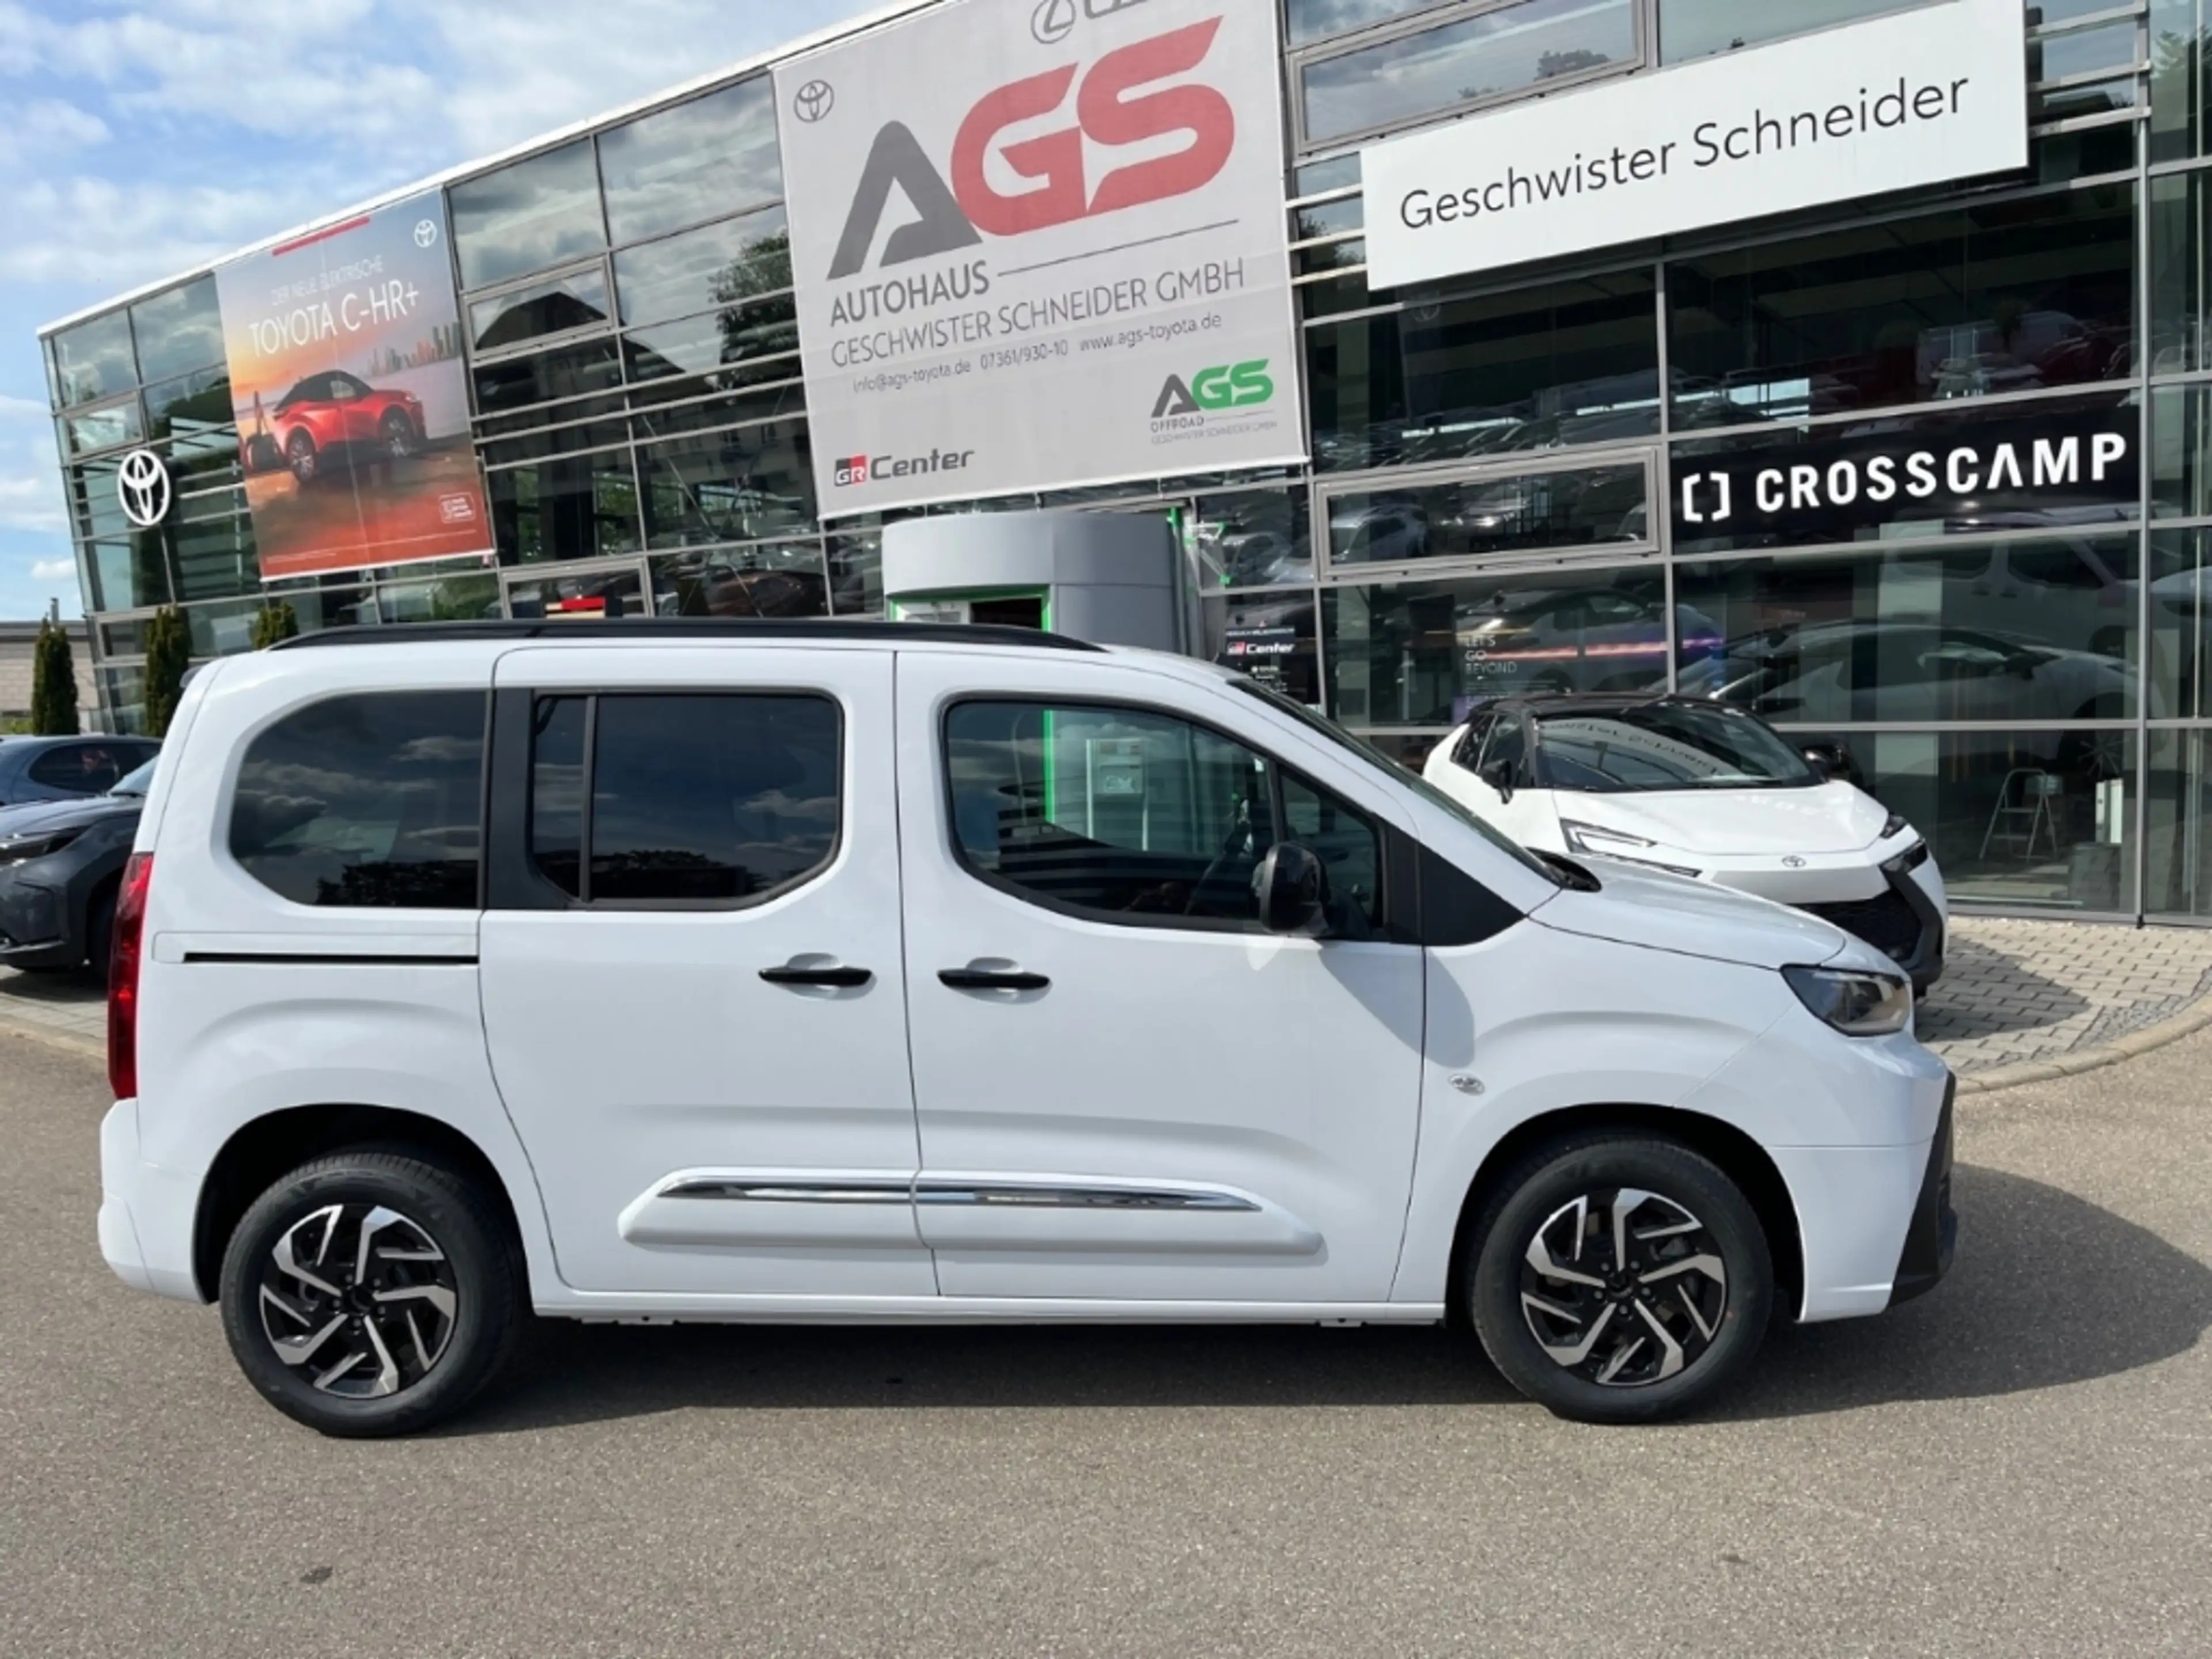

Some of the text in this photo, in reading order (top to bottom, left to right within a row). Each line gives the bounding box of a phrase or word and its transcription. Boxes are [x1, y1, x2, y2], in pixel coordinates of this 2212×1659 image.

[826, 15, 1235, 281] AGS
[1400, 77, 1968, 229] Geschwister Schneider
[249, 279, 419, 357] TOYOTA C-HR+
[830, 259, 989, 327] AUTOHAUS
[831, 257, 1244, 367] GESCHWISTER SCHNEIDER GMBH
[980, 339, 1068, 370] 07361/930-10
[1079, 311, 1222, 351] www.ags-toyota.de
[1150, 358, 1274, 418] AGS
[1150, 415, 1205, 433] OFFROAD
[870, 448, 975, 480] Center
[1755, 433, 2127, 512] CROSSCAMP
[1464, 650, 1487, 661] GO
